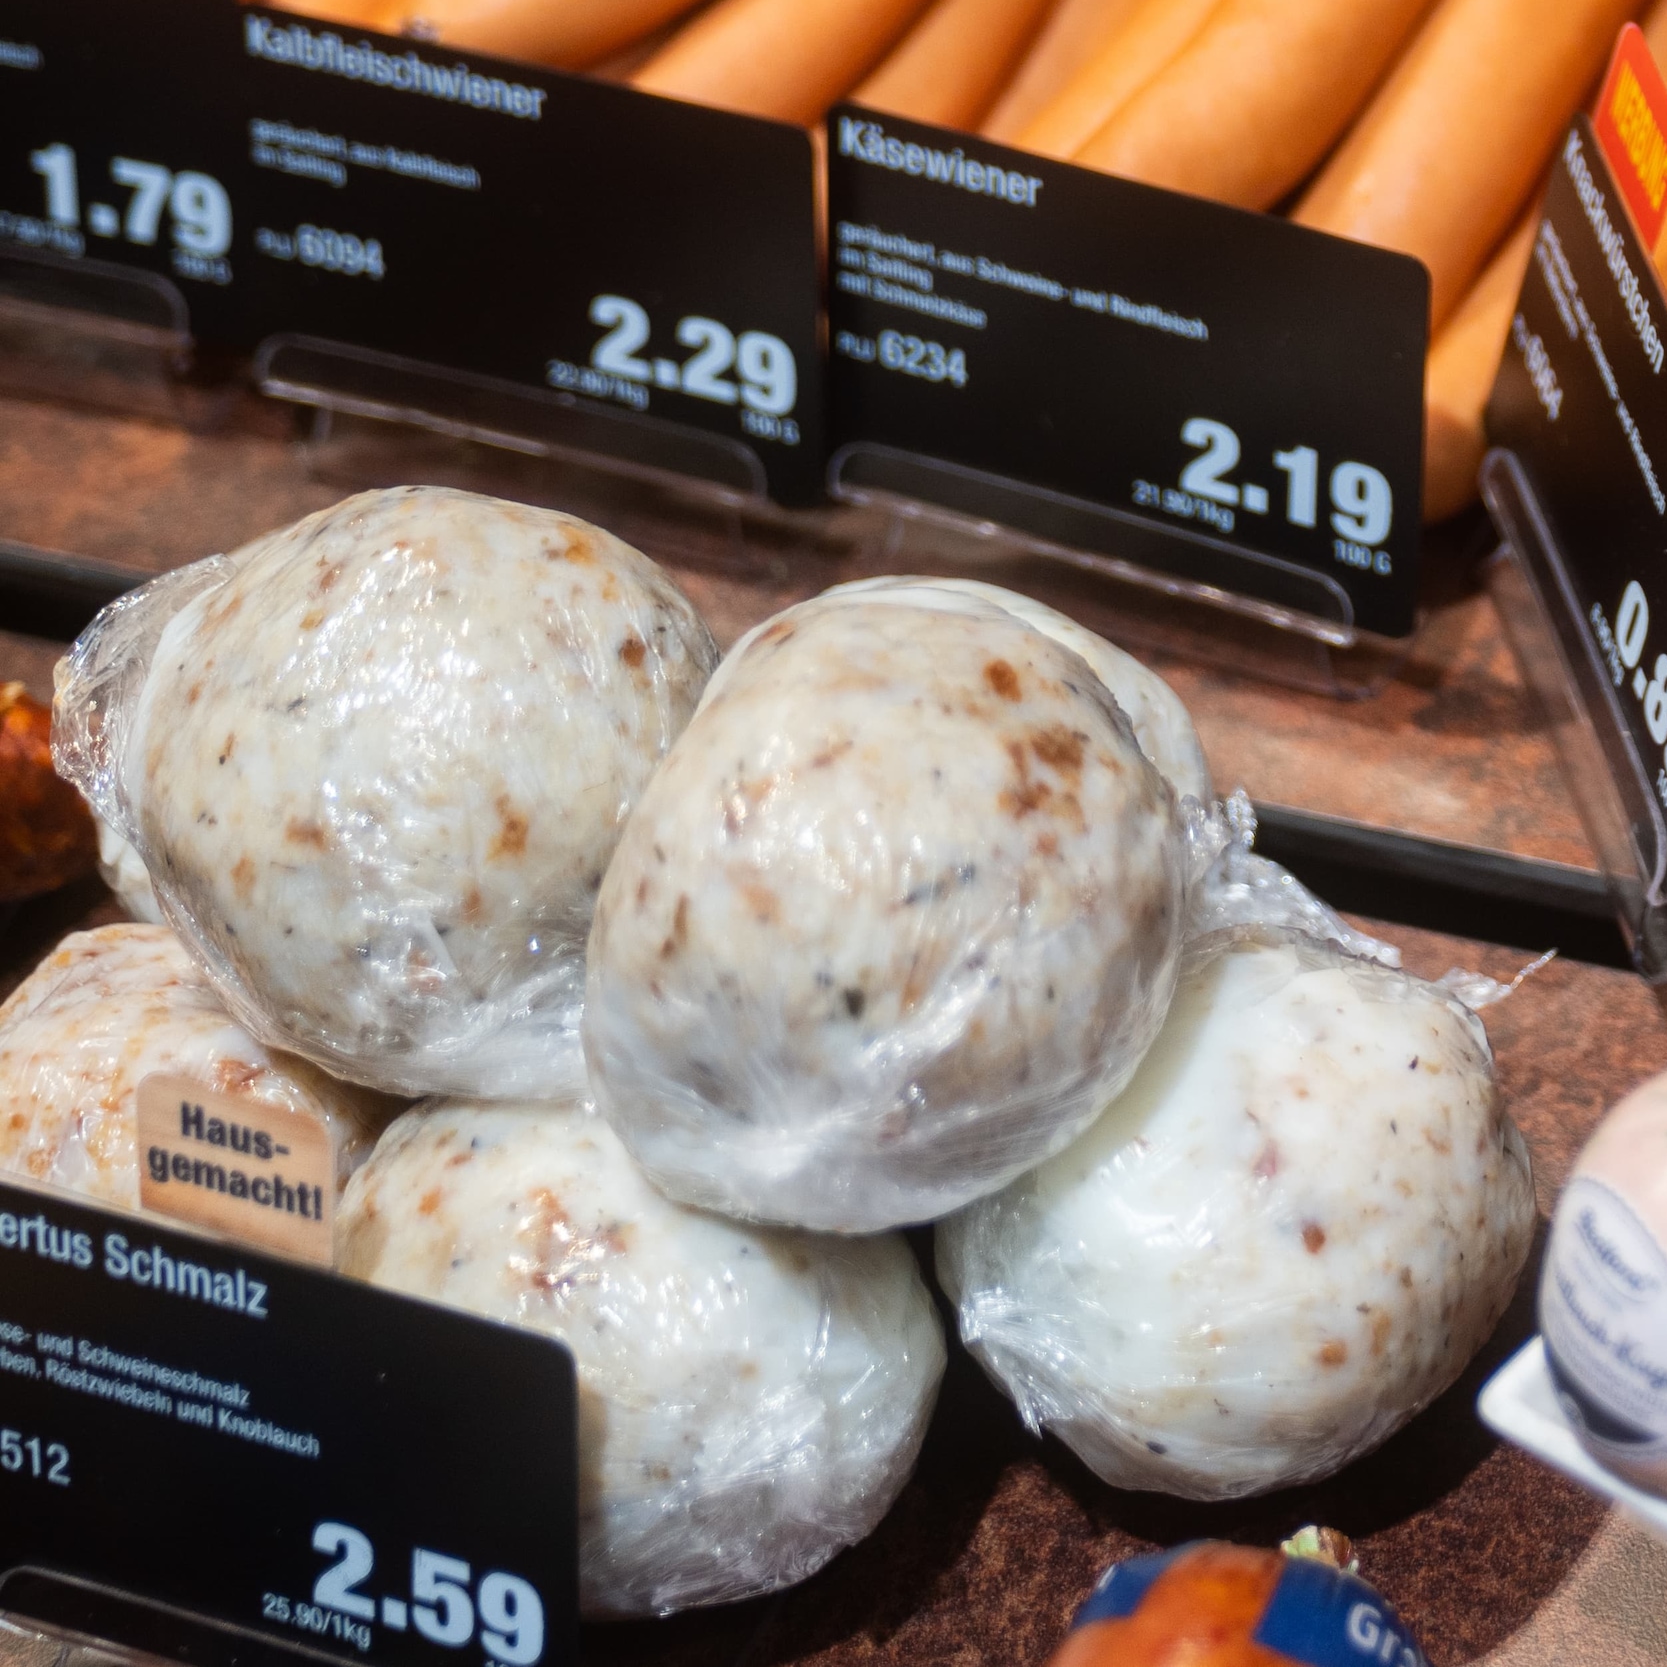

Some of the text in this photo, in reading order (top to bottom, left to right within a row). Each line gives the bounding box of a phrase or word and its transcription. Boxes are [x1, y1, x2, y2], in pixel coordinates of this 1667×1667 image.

[246, 13, 546, 121] Kalbfleischwiener
[30, 143, 232, 258] 1.79
[838, 115, 1044, 208] Käsewiener
[1563, 128, 1664, 373] Knackwürstchen
[588, 294, 797, 416] 2.29
[877, 328, 967, 388] 6234
[1180, 417, 1392, 546] 2.19
[1334, 539, 1392, 575] 100 G
[180, 1100, 291, 1162] Haus-
[146, 1144, 324, 1223] gemacht!
[0, 1211, 269, 1321] ertus Schmalz
[36, 1332, 74, 1360] und
[76, 1338, 251, 1409] Schweineschmalz
[44, 1357, 174, 1416] Röstzwiebeln
[176, 1399, 214, 1428] und
[217, 1407, 321, 1460] Knoblauch
[262, 1591, 372, 1653] 25.90/1kg
[311, 1520, 545, 1666] 2.59
